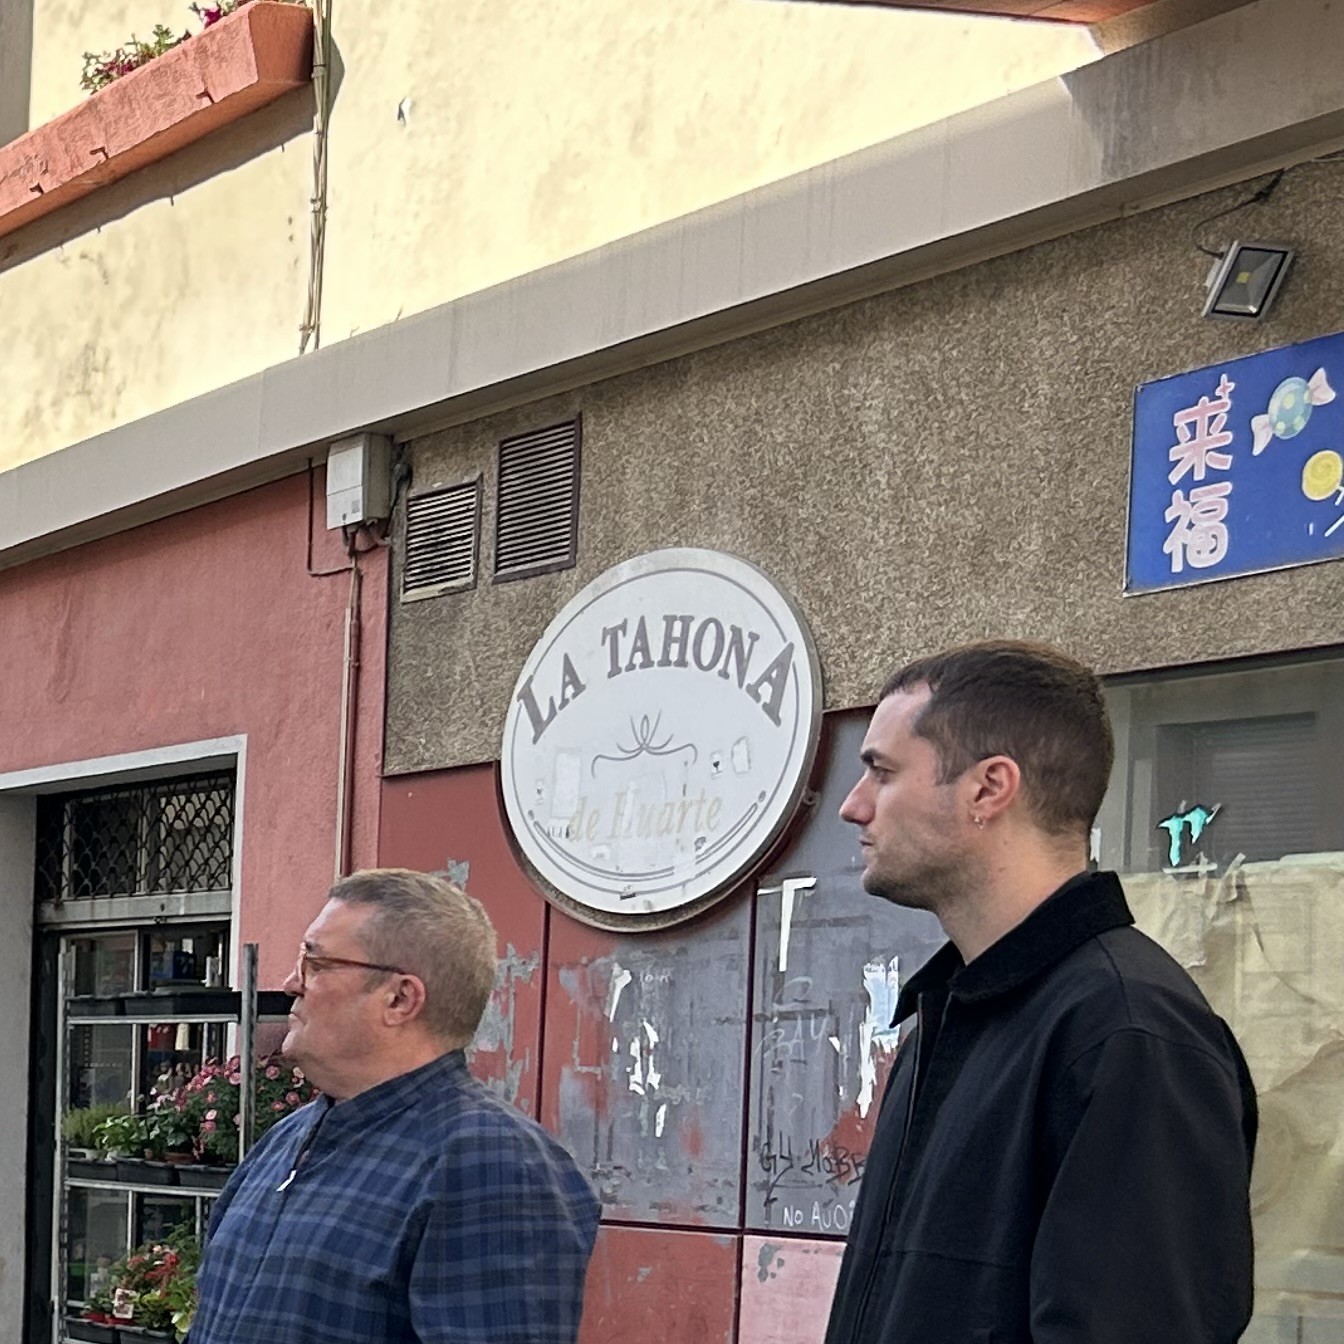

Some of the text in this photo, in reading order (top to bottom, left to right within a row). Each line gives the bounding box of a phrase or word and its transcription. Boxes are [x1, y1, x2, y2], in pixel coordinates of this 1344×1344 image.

[1163, 396, 1233, 574] 来福
[516, 614, 795, 745] LA TAHONA
